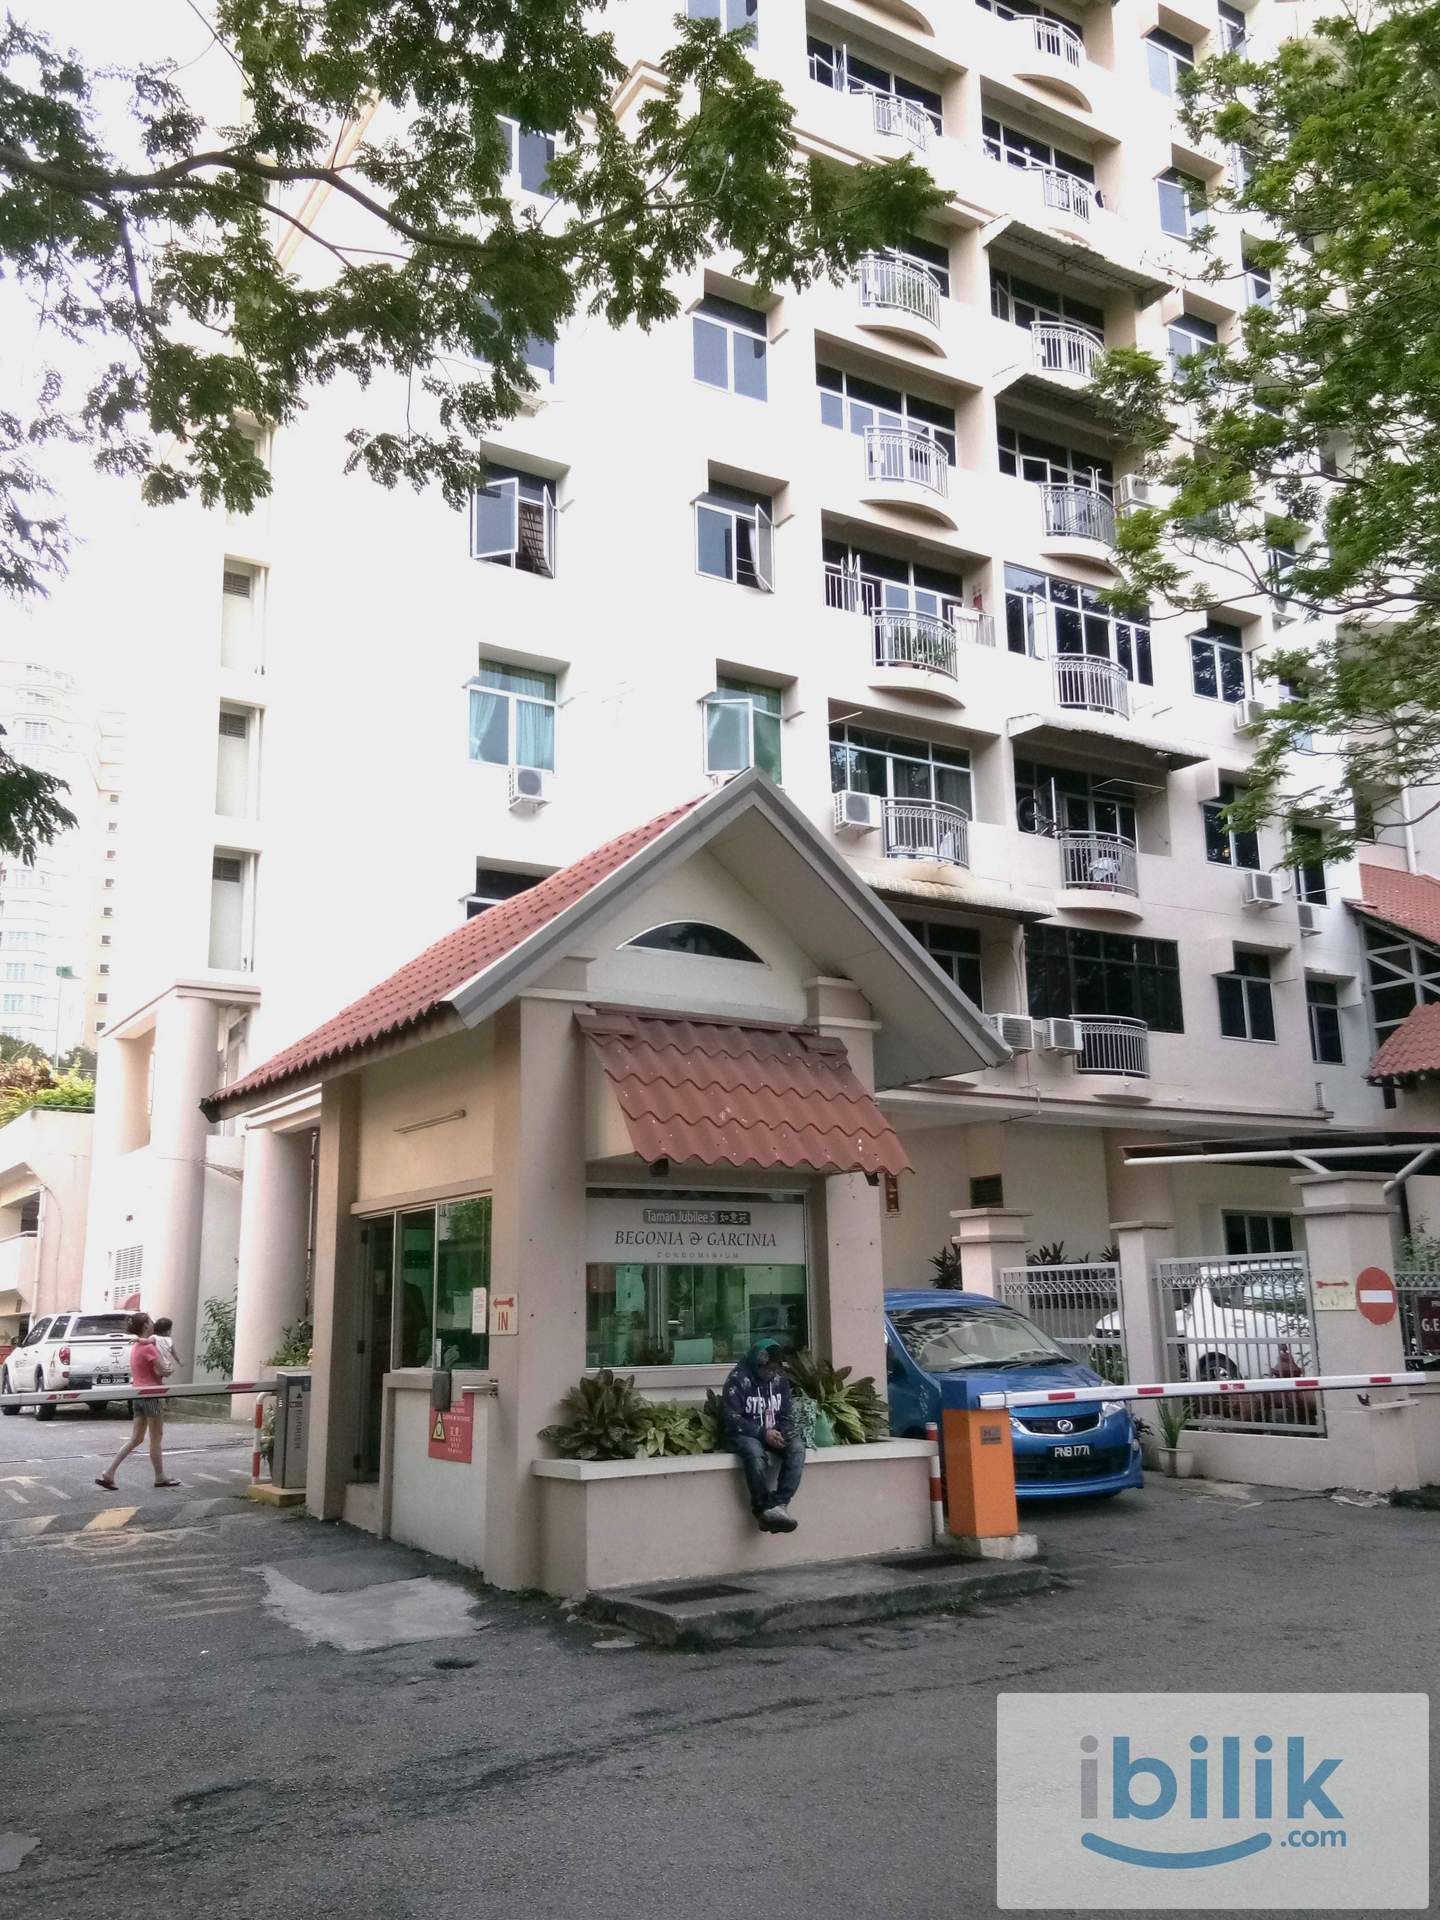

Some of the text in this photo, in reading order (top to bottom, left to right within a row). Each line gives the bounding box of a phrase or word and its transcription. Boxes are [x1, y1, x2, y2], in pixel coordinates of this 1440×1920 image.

[645, 1209, 676, 1222] Taman
[677, 1210, 709, 1223] Jubilee
[615, 1230, 777, 1247] BEGONIA & GARCINIA
[656, 1251, 739, 1259] CONDOMINIUM
[497, 1311, 509, 1331] IN
